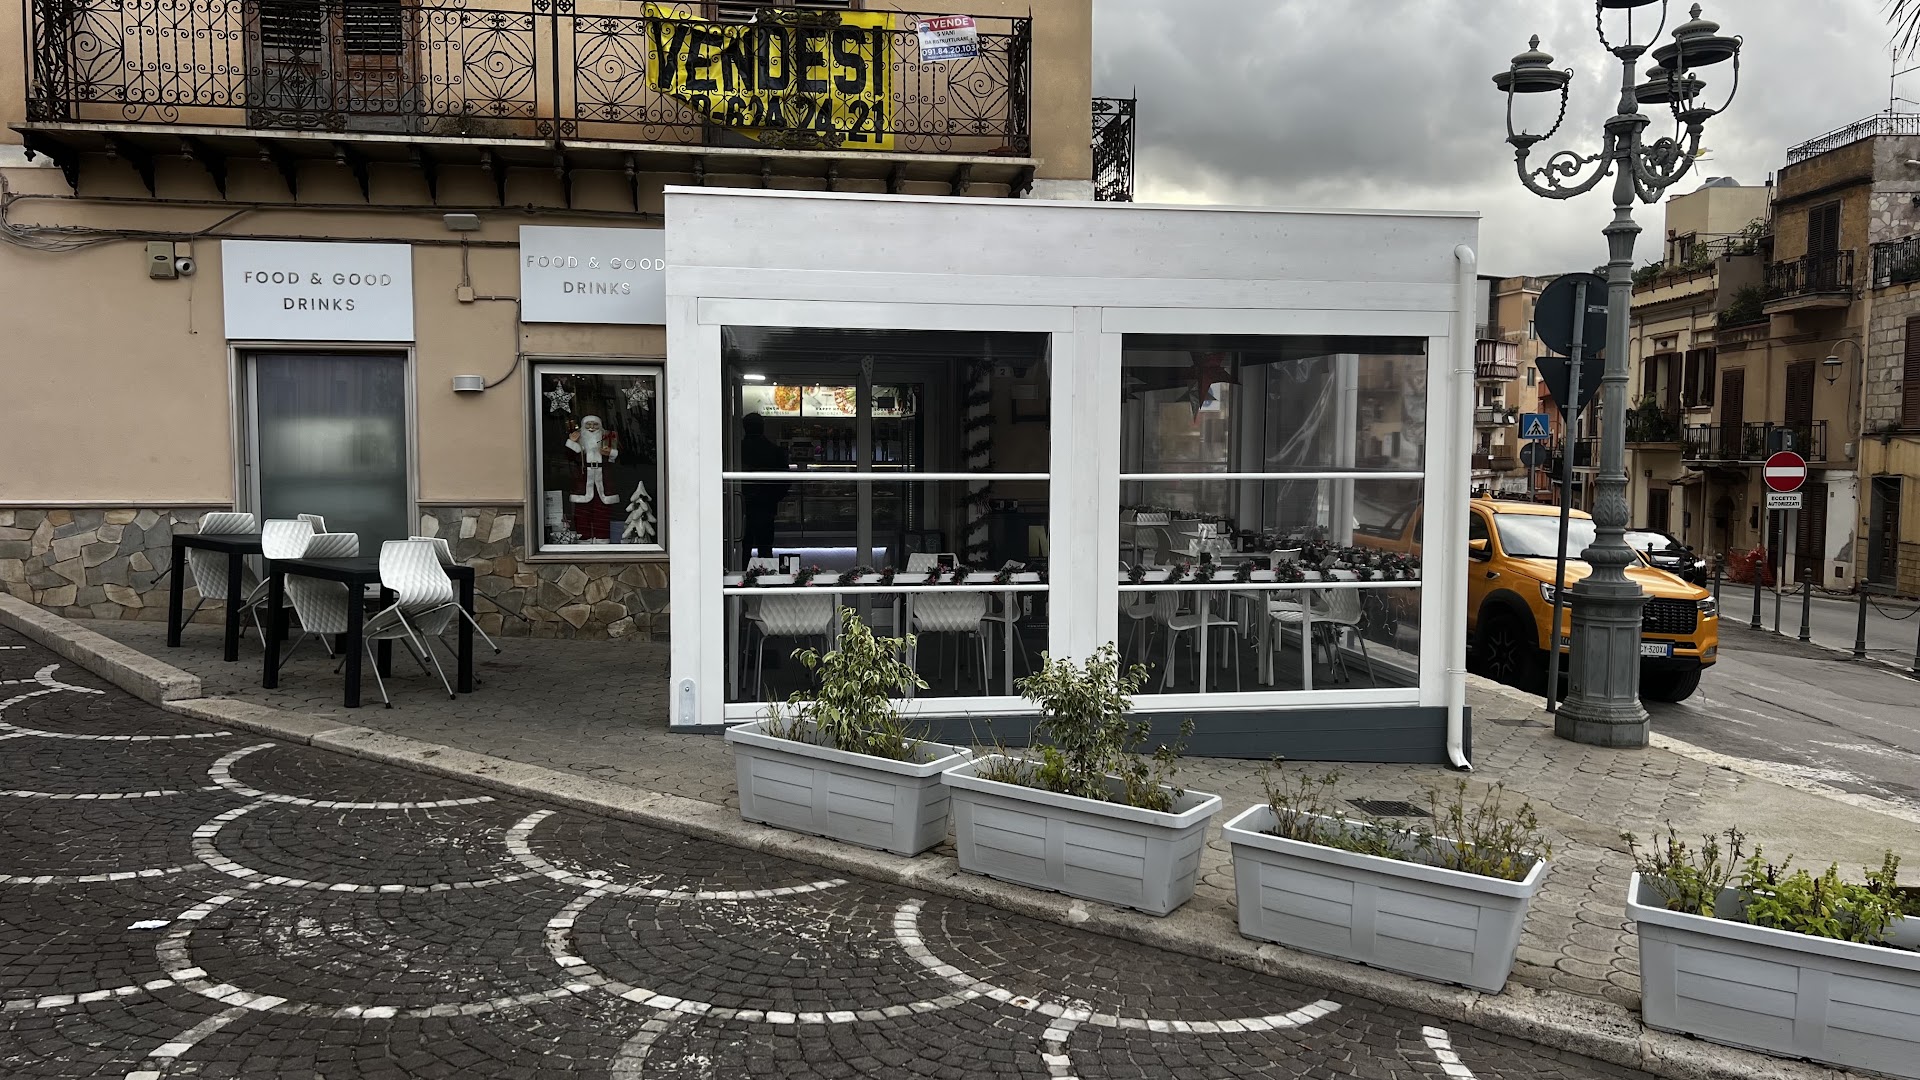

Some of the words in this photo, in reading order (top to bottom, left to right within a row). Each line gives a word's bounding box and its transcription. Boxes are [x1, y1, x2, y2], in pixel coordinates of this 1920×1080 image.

[932, 18, 969, 29] VENDE
[922, 44, 976, 56] 091.84.20.103
[651, 21, 883, 96] VENDESI
[526, 255, 578, 268] FOOD
[588, 256, 600, 269] &
[610, 257, 665, 271] GOOD
[244, 271, 300, 284] FOOD
[310, 272, 322, 285] &
[332, 273, 392, 286] GOOD
[563, 281, 631, 295] DRINKS
[283, 297, 355, 311] DRINKS
